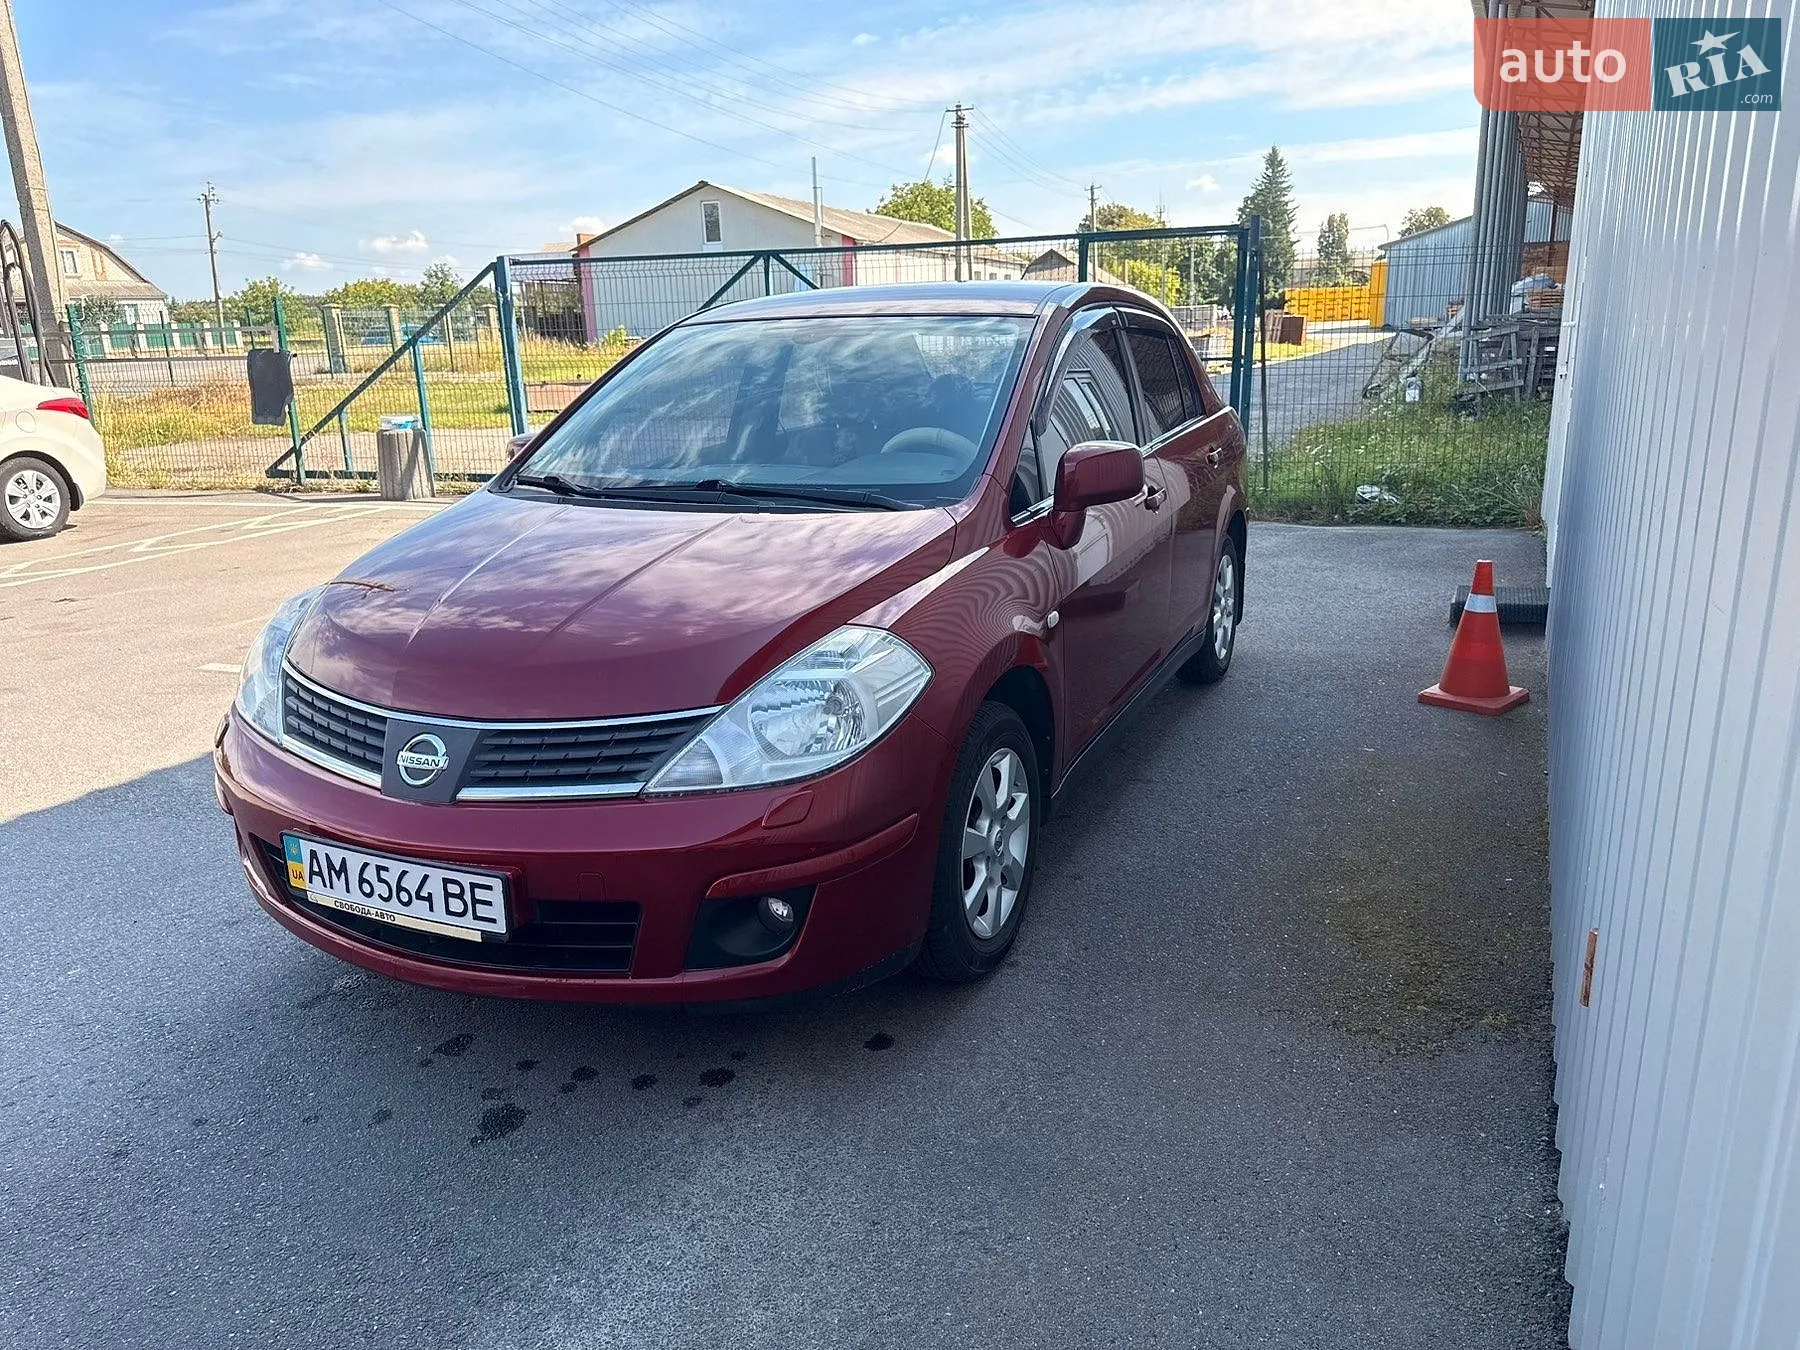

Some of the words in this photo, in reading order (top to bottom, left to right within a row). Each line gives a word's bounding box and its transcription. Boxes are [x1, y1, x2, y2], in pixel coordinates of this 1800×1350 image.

[400, 754, 441, 767] NISSAN
[292, 869, 305, 882] UA
[308, 848, 351, 894] AM
[358, 861, 434, 913] 6564
[441, 877, 497, 924] BE
[334, 900, 396, 922] СВОБОДА-АВТО
